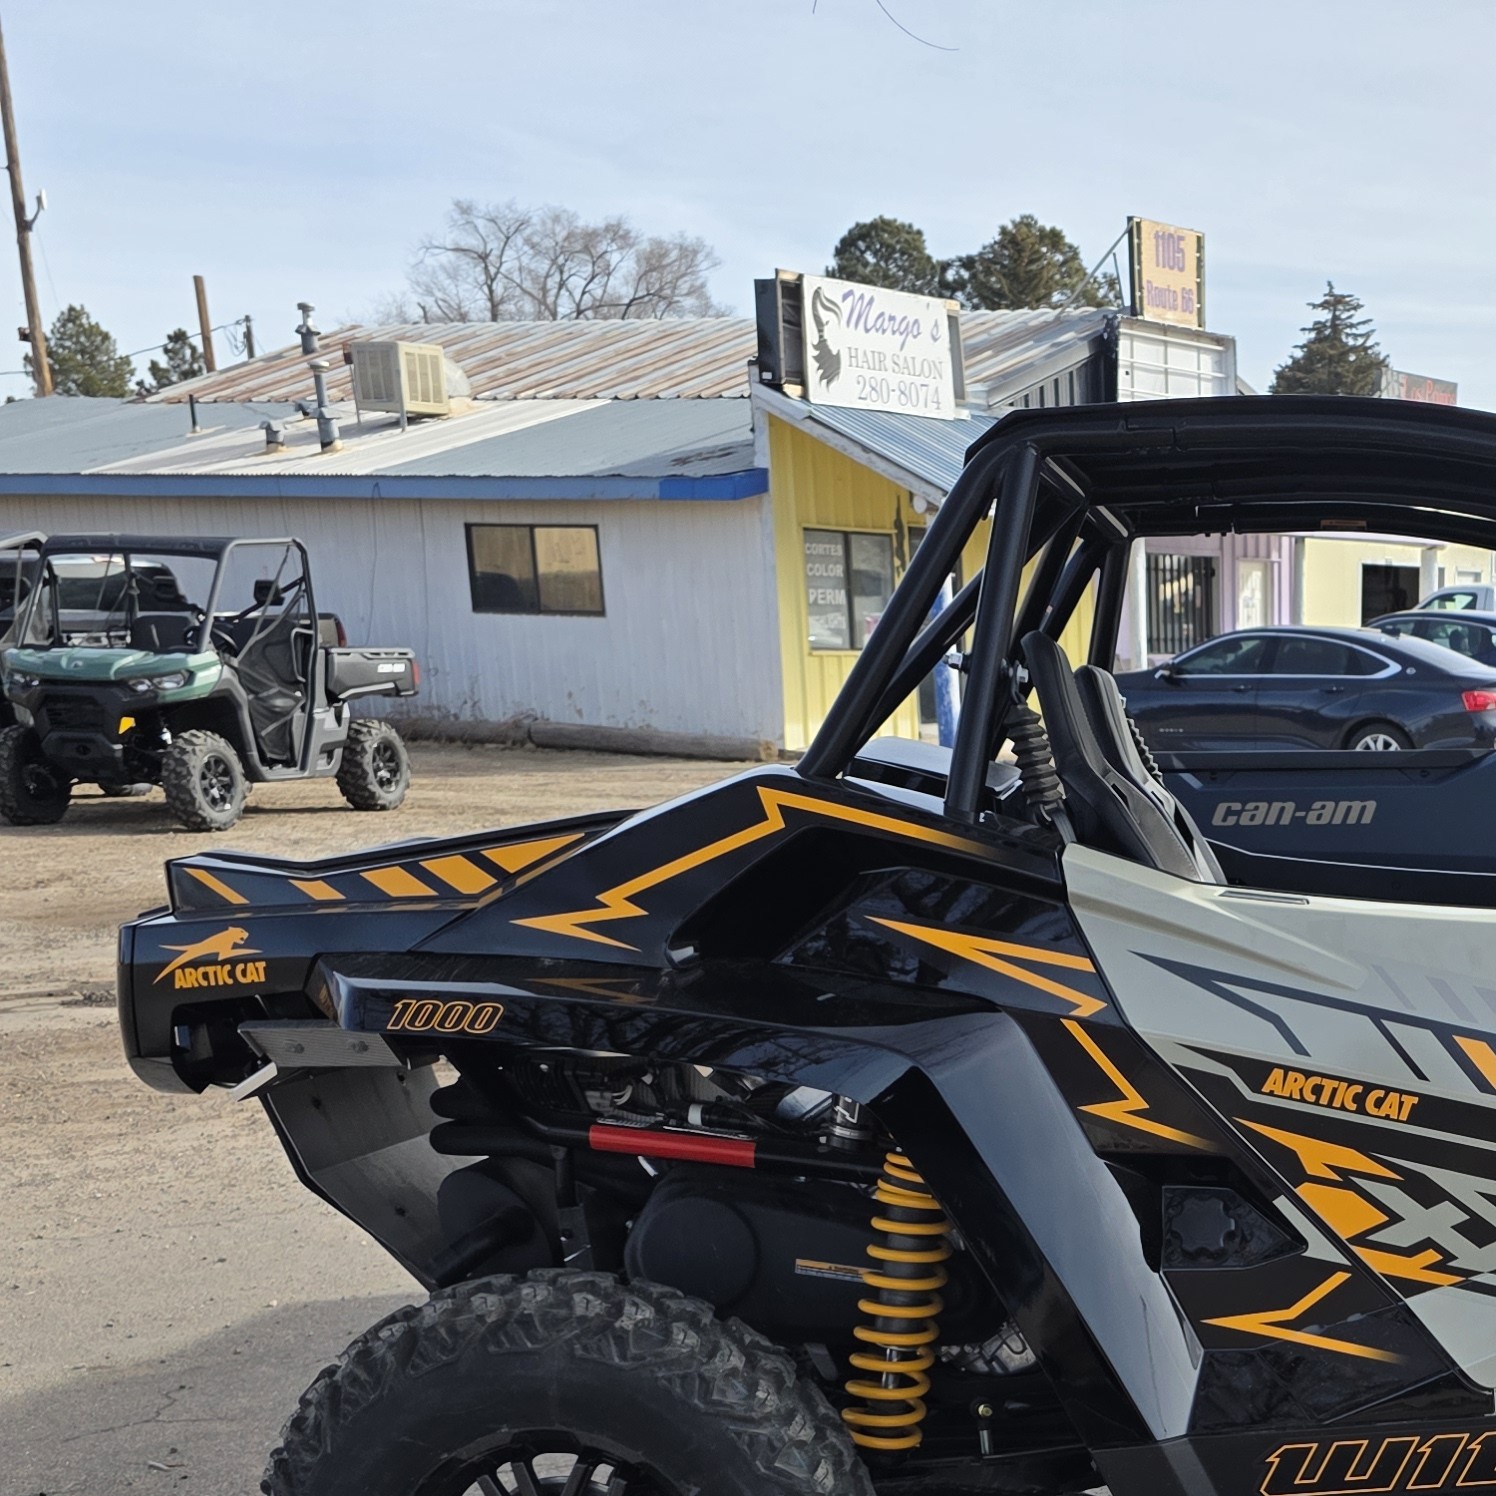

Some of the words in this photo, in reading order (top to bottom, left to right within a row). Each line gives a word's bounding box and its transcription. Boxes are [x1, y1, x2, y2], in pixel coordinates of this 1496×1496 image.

[1154, 230, 1185, 272] 1105
[1146, 280, 1178, 311] Route
[1181, 287, 1194, 314] 66
[848, 347, 888, 372] HAIR
[891, 353, 943, 380] SALON
[856, 374, 941, 410] 280-8074
[807, 563, 845, 577] COLOR
[1211, 800, 1377, 826] can-am
[174, 963, 233, 989] ARCTIC
[235, 961, 267, 984] CAT
[387, 999, 504, 1034] 1000
[1261, 1067, 1364, 1112] ARCTIC
[1364, 1089, 1419, 1122] CAT
